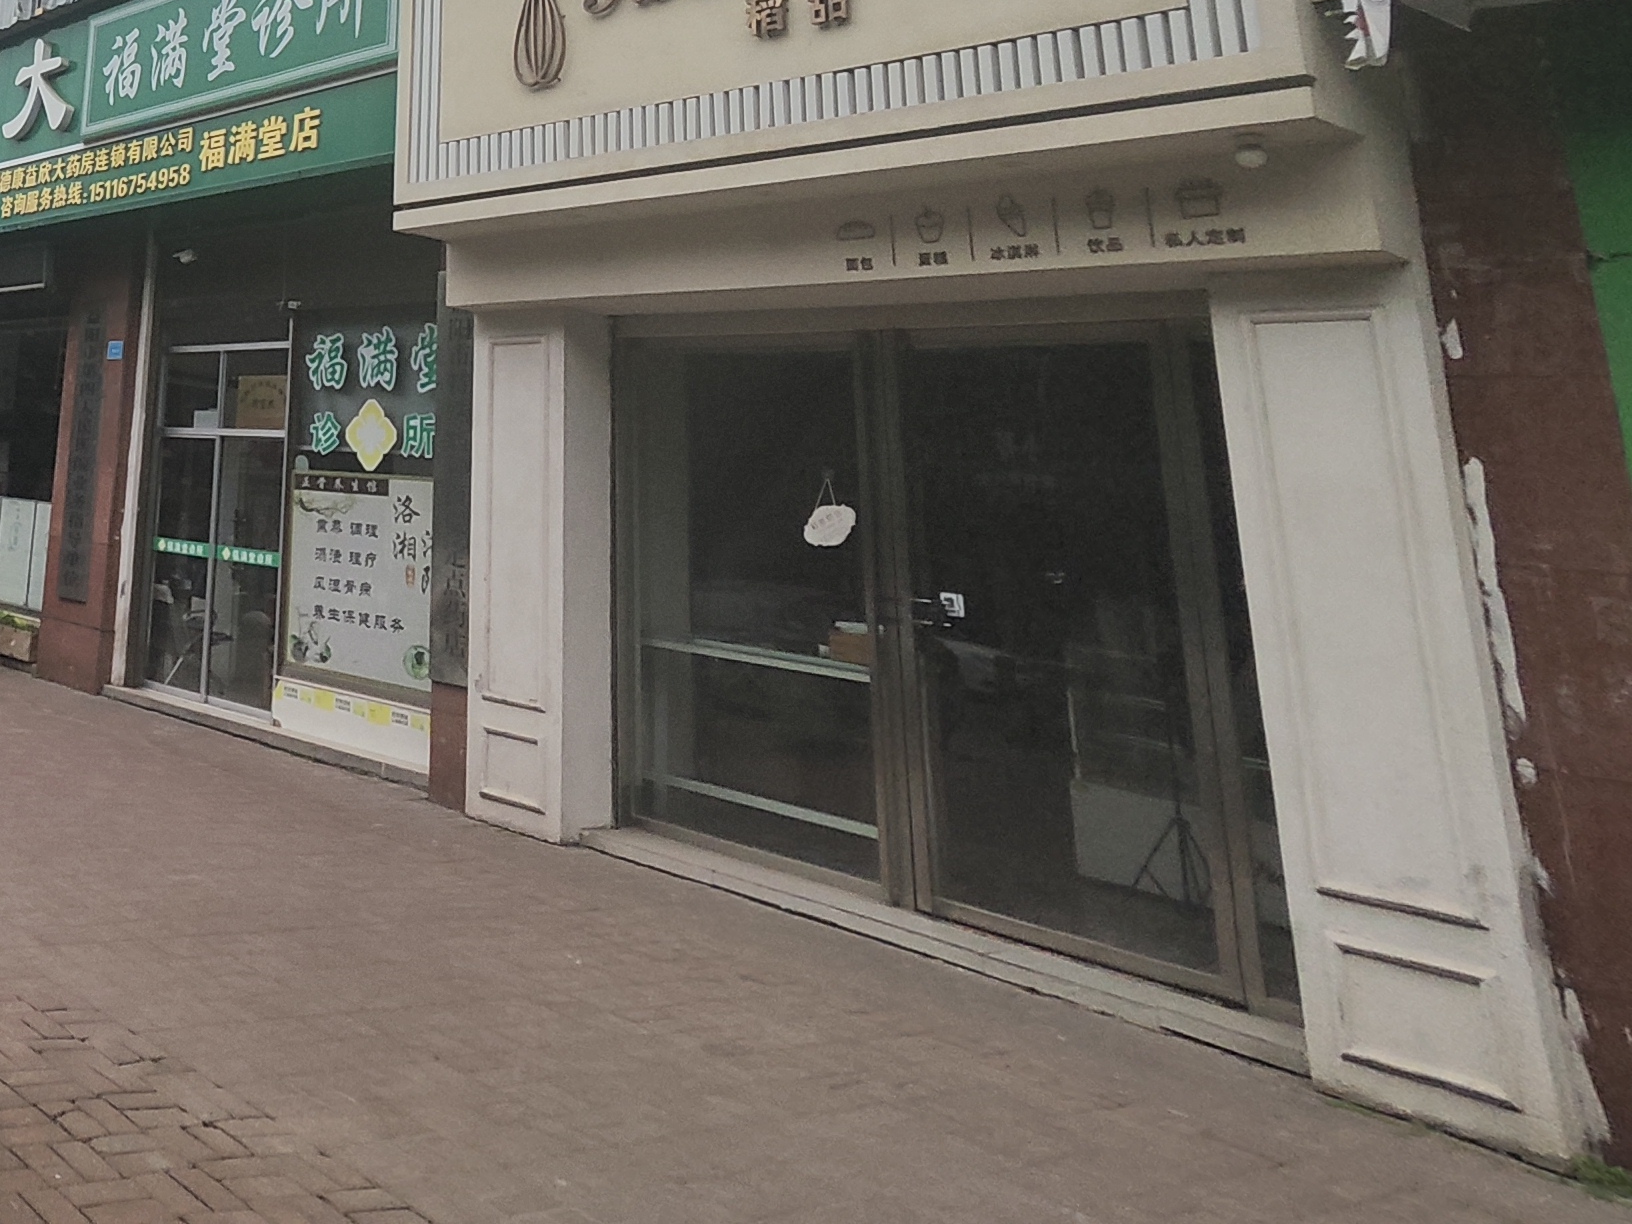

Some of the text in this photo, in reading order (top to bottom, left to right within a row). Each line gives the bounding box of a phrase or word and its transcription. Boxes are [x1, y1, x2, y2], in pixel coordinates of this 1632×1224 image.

[199, 107, 322, 172] 福满堂店
[306, 323, 437, 393] 福满堂
